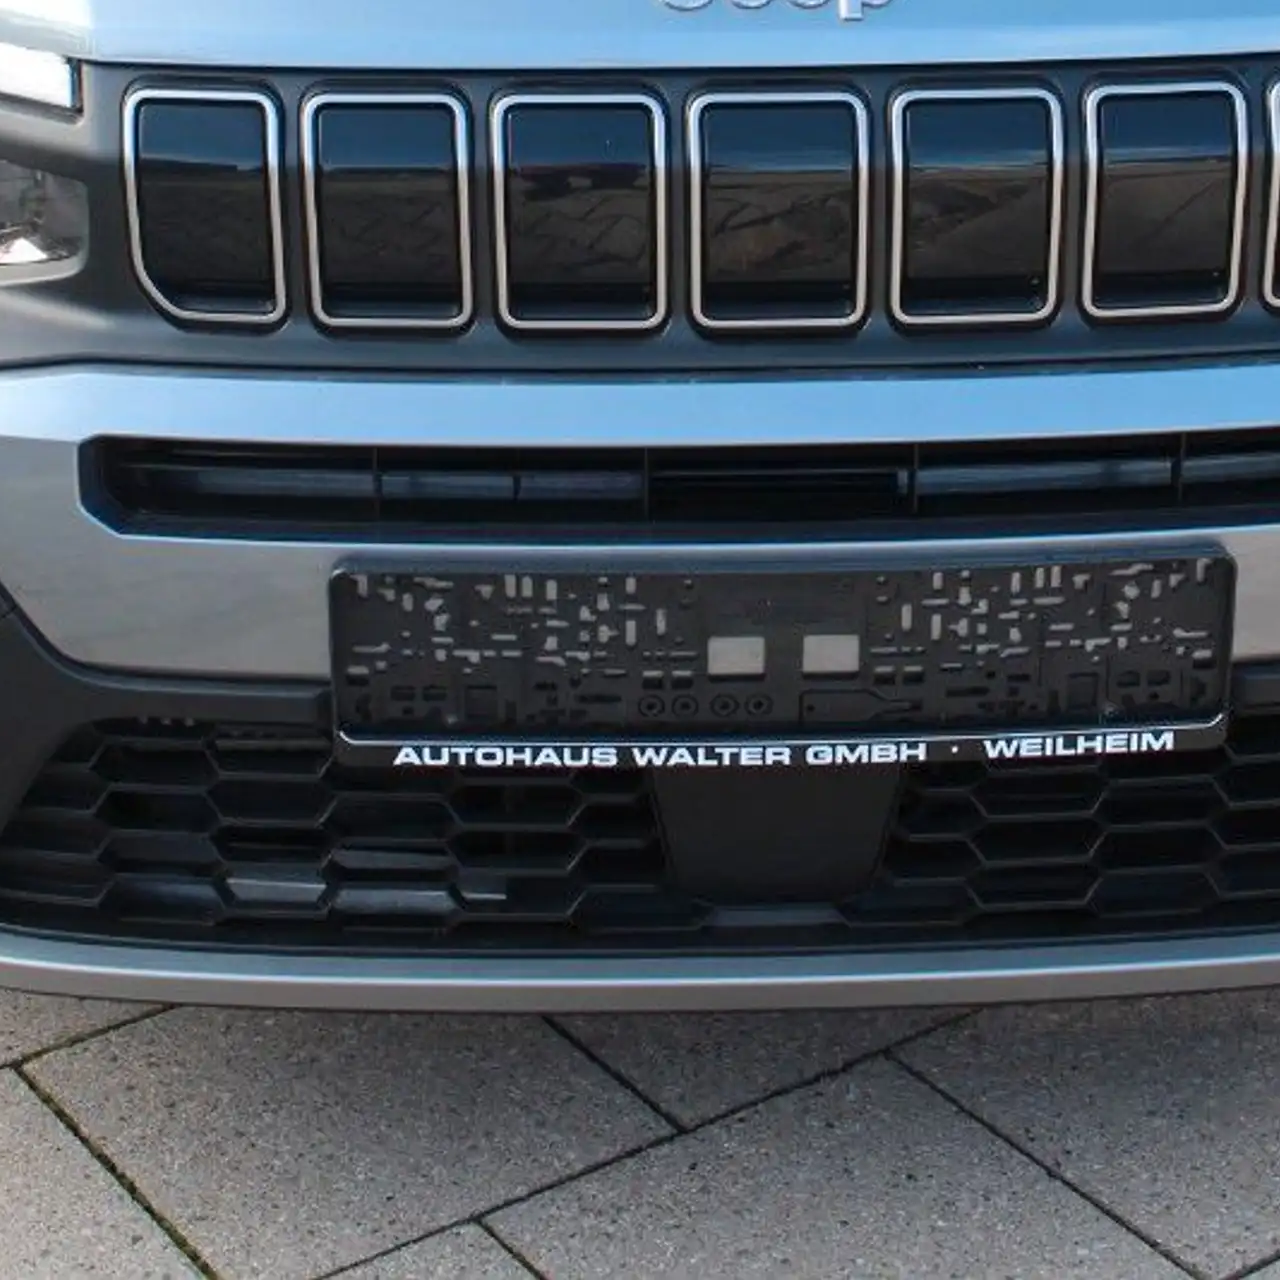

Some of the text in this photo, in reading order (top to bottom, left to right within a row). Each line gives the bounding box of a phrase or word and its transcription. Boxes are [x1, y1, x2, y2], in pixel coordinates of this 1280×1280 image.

[393, 731, 1175, 767] AUTOHAUS WALTER GMBH WEILHEIM
